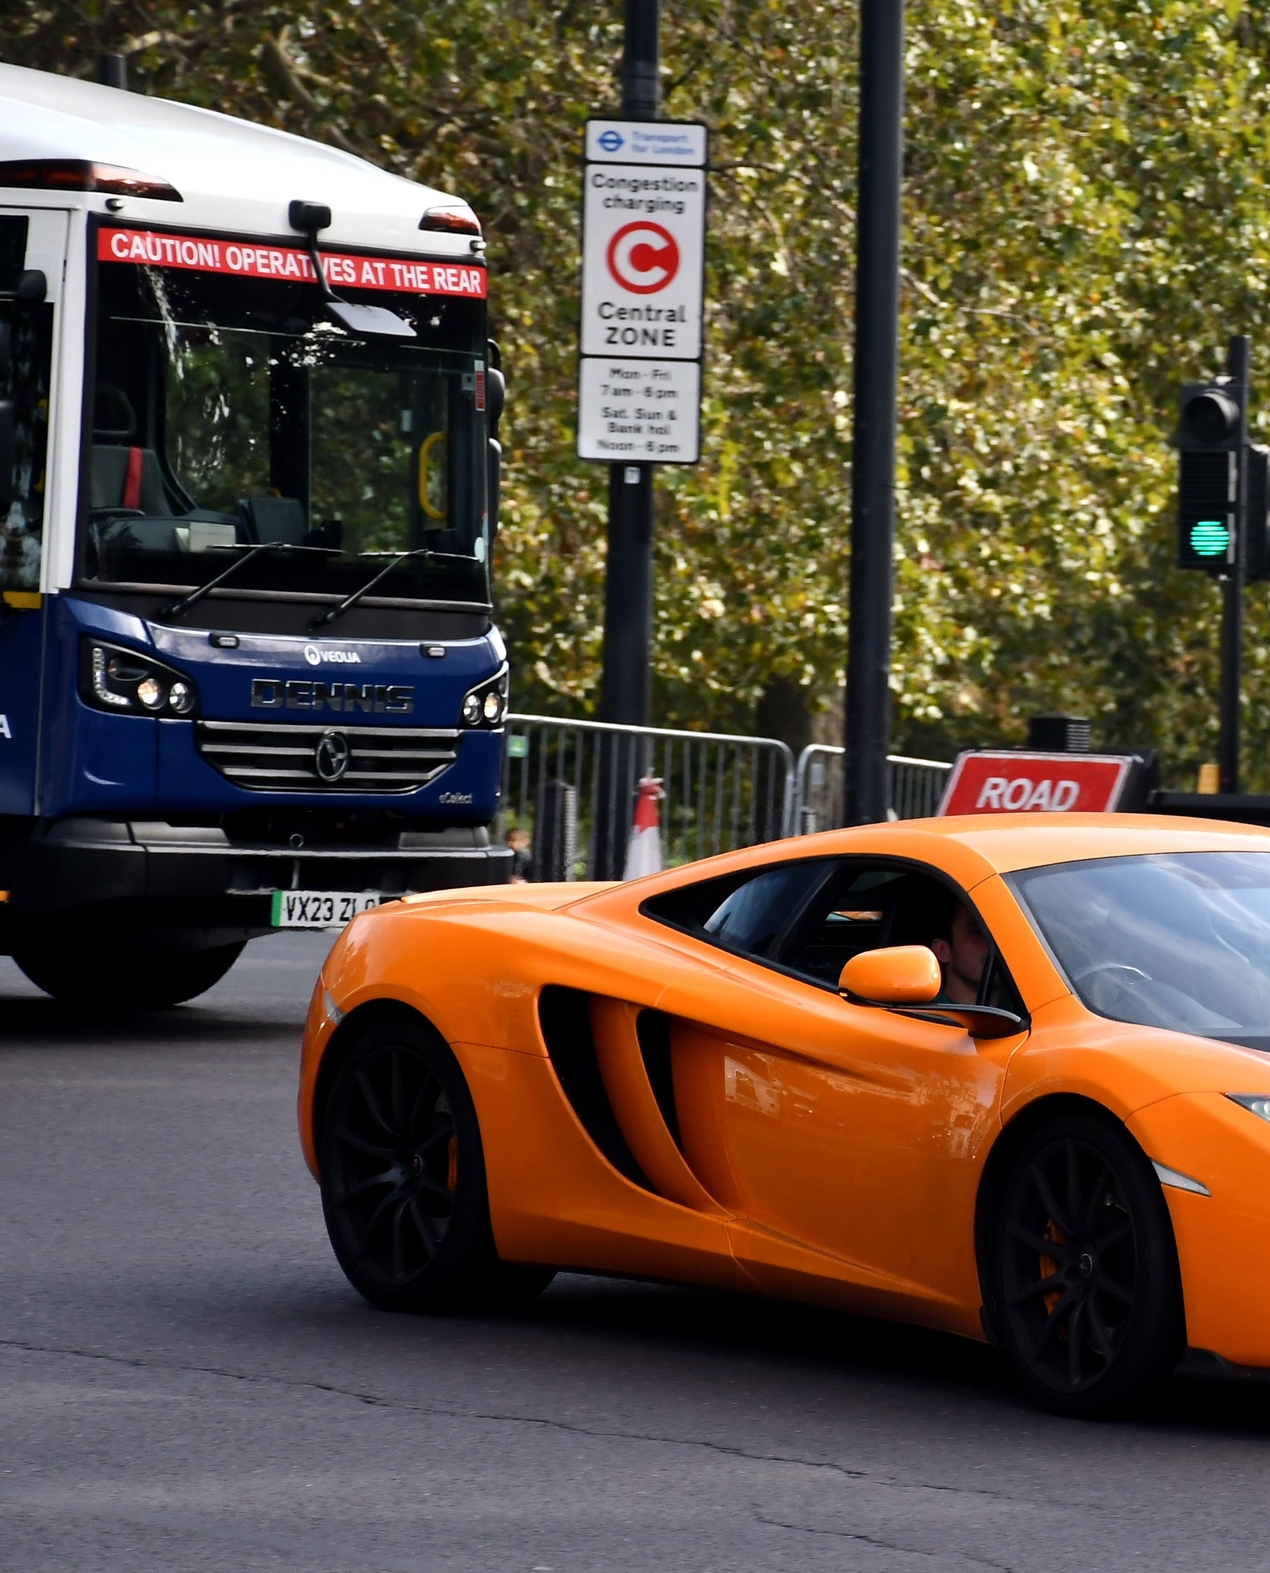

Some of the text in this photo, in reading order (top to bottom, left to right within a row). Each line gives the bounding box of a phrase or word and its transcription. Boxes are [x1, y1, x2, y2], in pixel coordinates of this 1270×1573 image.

[632, 131, 688, 143] Transport
[632, 144, 694, 155] for London
[592, 173, 699, 193] Congestion
[603, 195, 685, 215] charging
[111, 233, 220, 268] CAUTION!
[361, 261, 386, 286] AT
[390, 264, 431, 290] THE
[434, 267, 482, 294] REAR
[598, 301, 687, 323] Central
[605, 327, 676, 347] ZONE
[609, 368, 640, 380] Mon
[635, 408, 664, 420] Sun
[608, 422, 644, 434] Bank
[320, 650, 361, 663] VEOLIA
[251, 678, 415, 715] DENNIS
[976, 777, 1081, 812] ROAD
[286, 896, 334, 922] VX23
